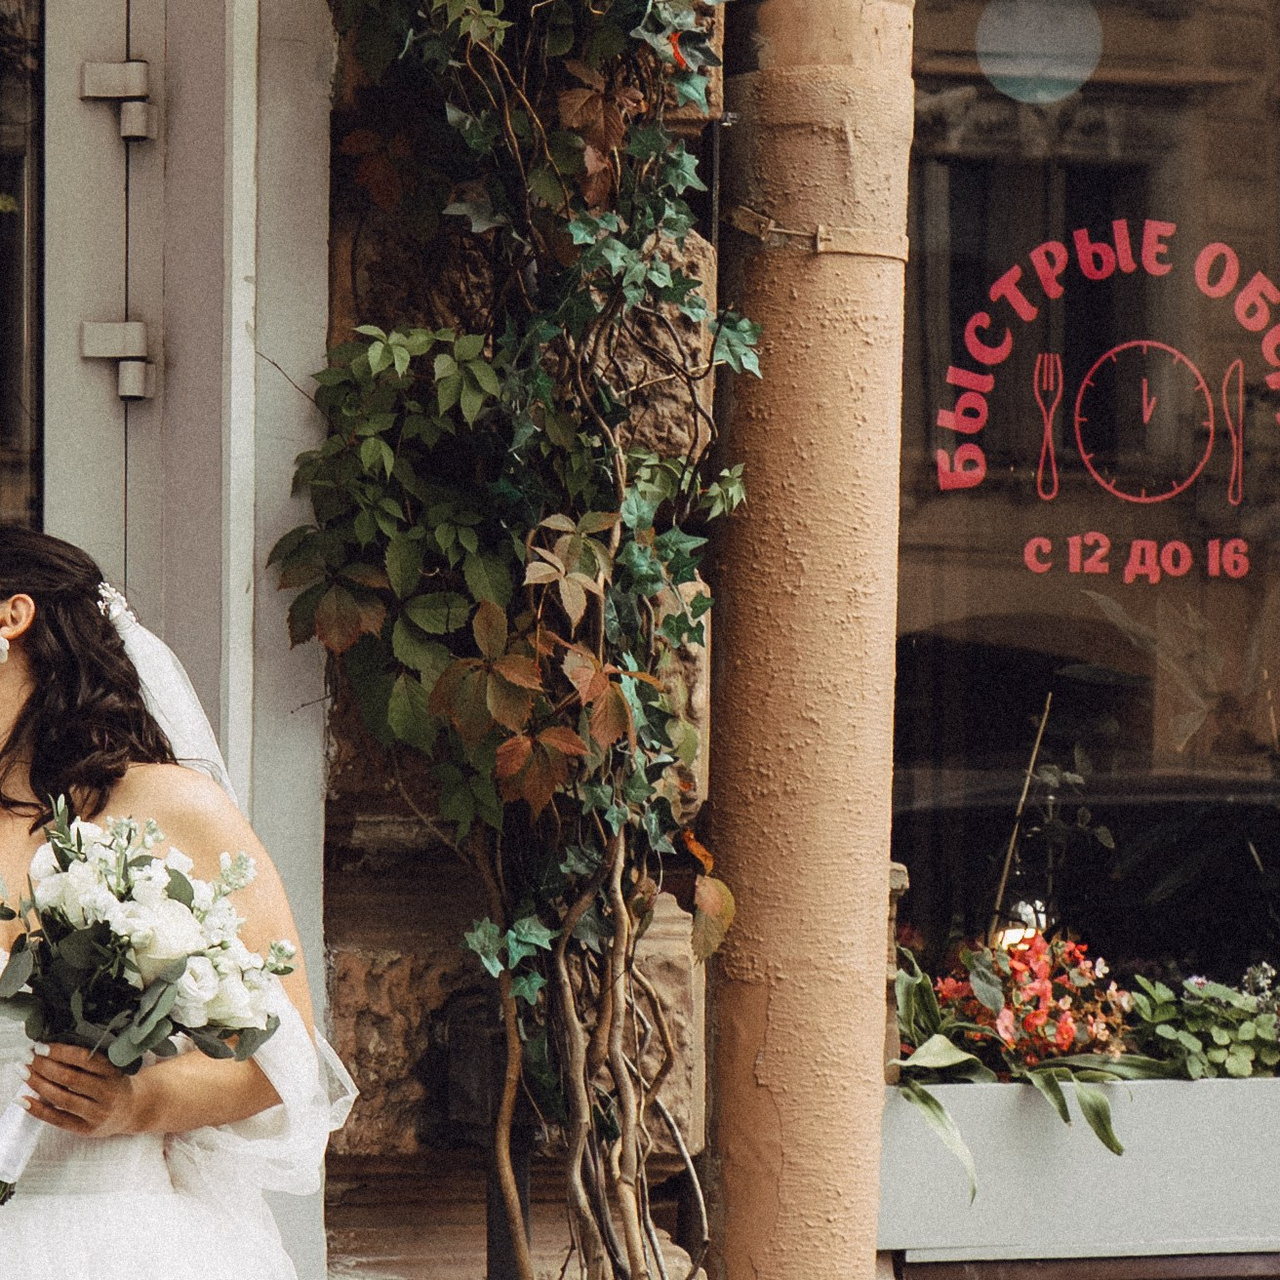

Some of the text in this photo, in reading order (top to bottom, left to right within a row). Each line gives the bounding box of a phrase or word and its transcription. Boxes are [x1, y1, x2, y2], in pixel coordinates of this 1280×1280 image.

[936, 218, 1176, 491] БЫСТРЫЕ
[1068, 531, 1111, 574] 12
[1207, 538, 1250, 578] 16
